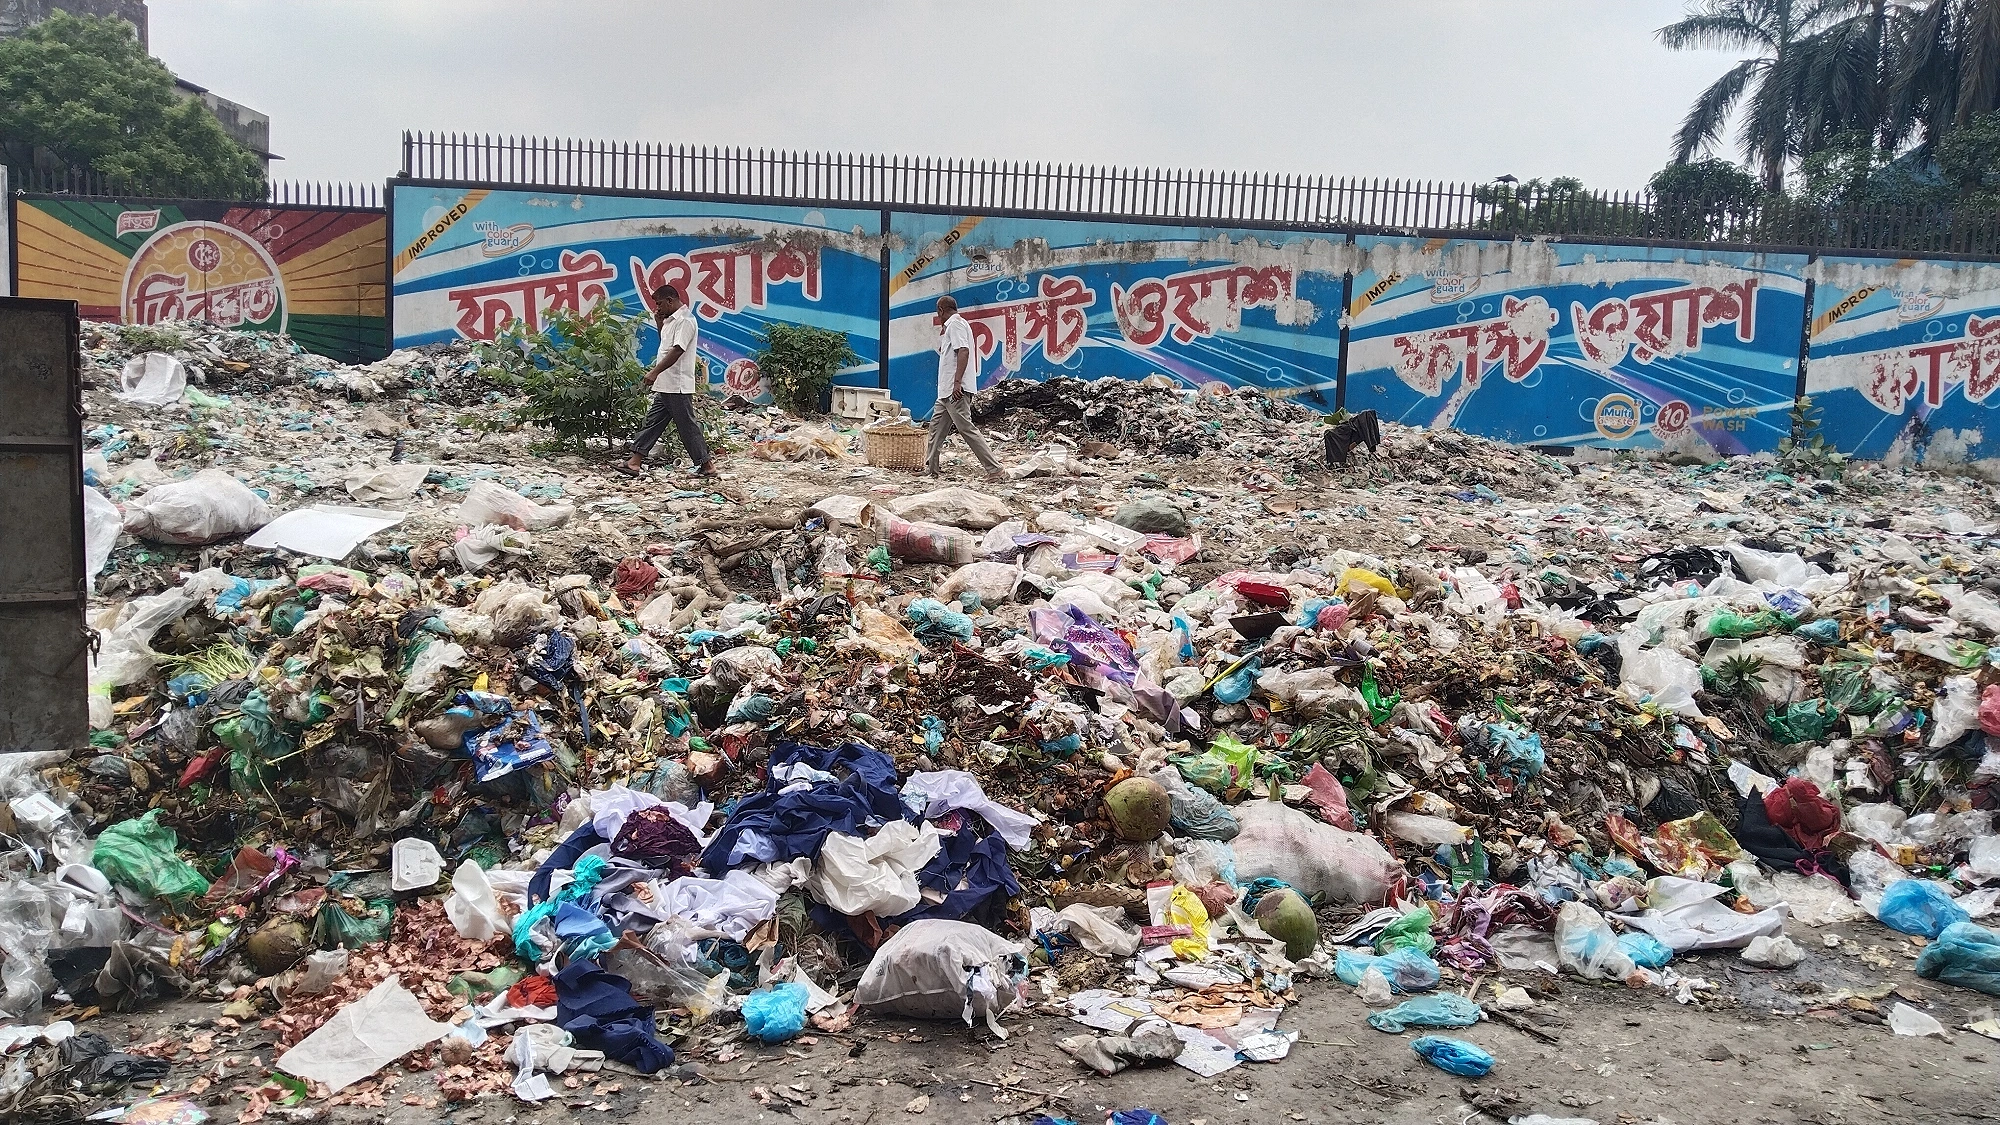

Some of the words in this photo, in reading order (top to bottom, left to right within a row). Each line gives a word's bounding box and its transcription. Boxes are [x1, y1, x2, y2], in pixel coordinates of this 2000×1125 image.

[408, 203, 468, 260] IMPROVED
[475, 221, 499, 232] with
[487, 229, 515, 239] color
[487, 237, 519, 248] guard
[904, 229, 960, 279] IMPED
[1436, 284, 1465, 294] guard
[731, 365, 755, 386] 10
[1604, 408, 1632, 418] Multi
[1664, 407, 1686, 428] 10
[1702, 405, 1759, 419] POWER
[1702, 419, 1746, 432] WASH
